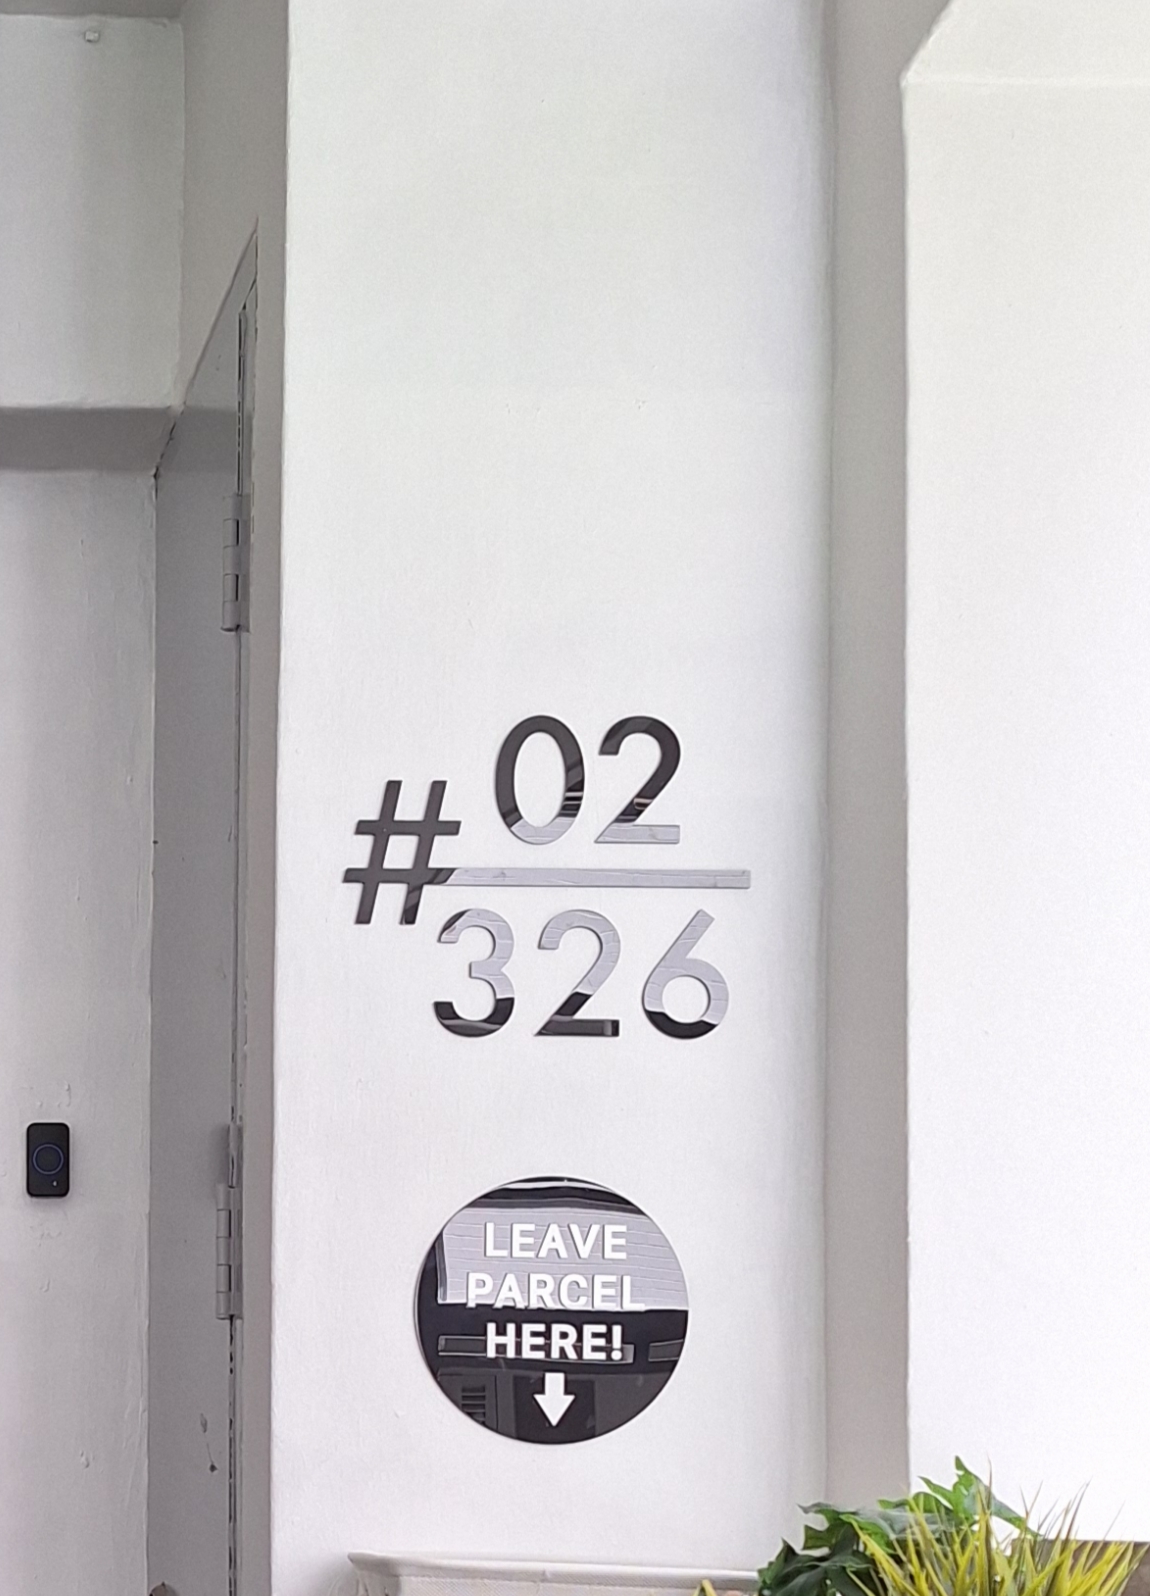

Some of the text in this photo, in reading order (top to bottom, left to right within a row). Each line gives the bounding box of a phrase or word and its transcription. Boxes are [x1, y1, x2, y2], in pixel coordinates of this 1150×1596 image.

[432, 908, 730, 1040] 326
[483, 1221, 628, 1260] LEAVE
[465, 1271, 646, 1311] PARCEL
[485, 1321, 624, 1362] HERE!
